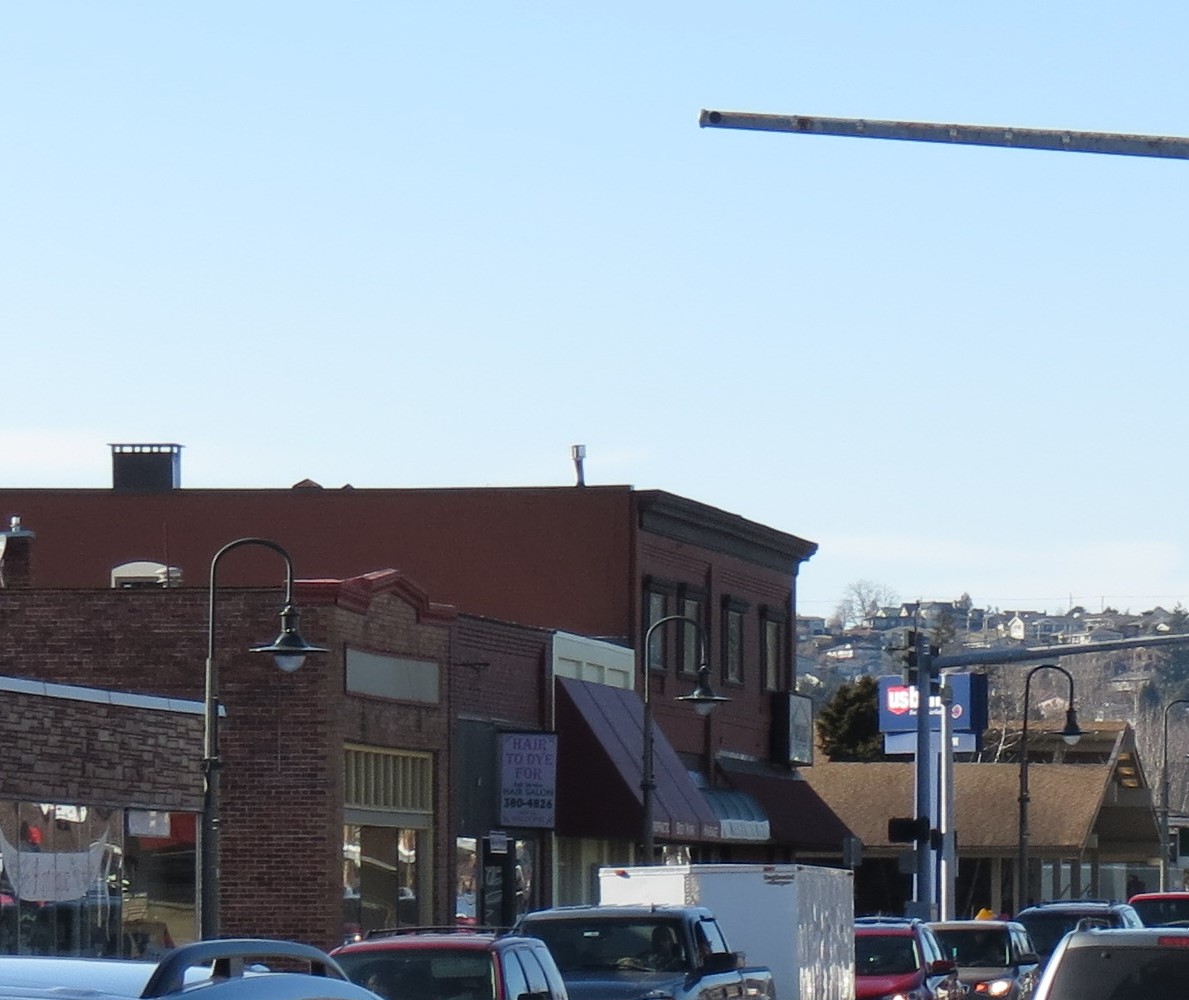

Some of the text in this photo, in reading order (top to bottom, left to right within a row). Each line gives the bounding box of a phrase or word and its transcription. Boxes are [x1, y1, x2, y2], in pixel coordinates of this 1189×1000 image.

[512, 738, 547, 750] HAIR
[505, 752, 554, 766] TO DYE
[515, 767, 543, 780] FOR
